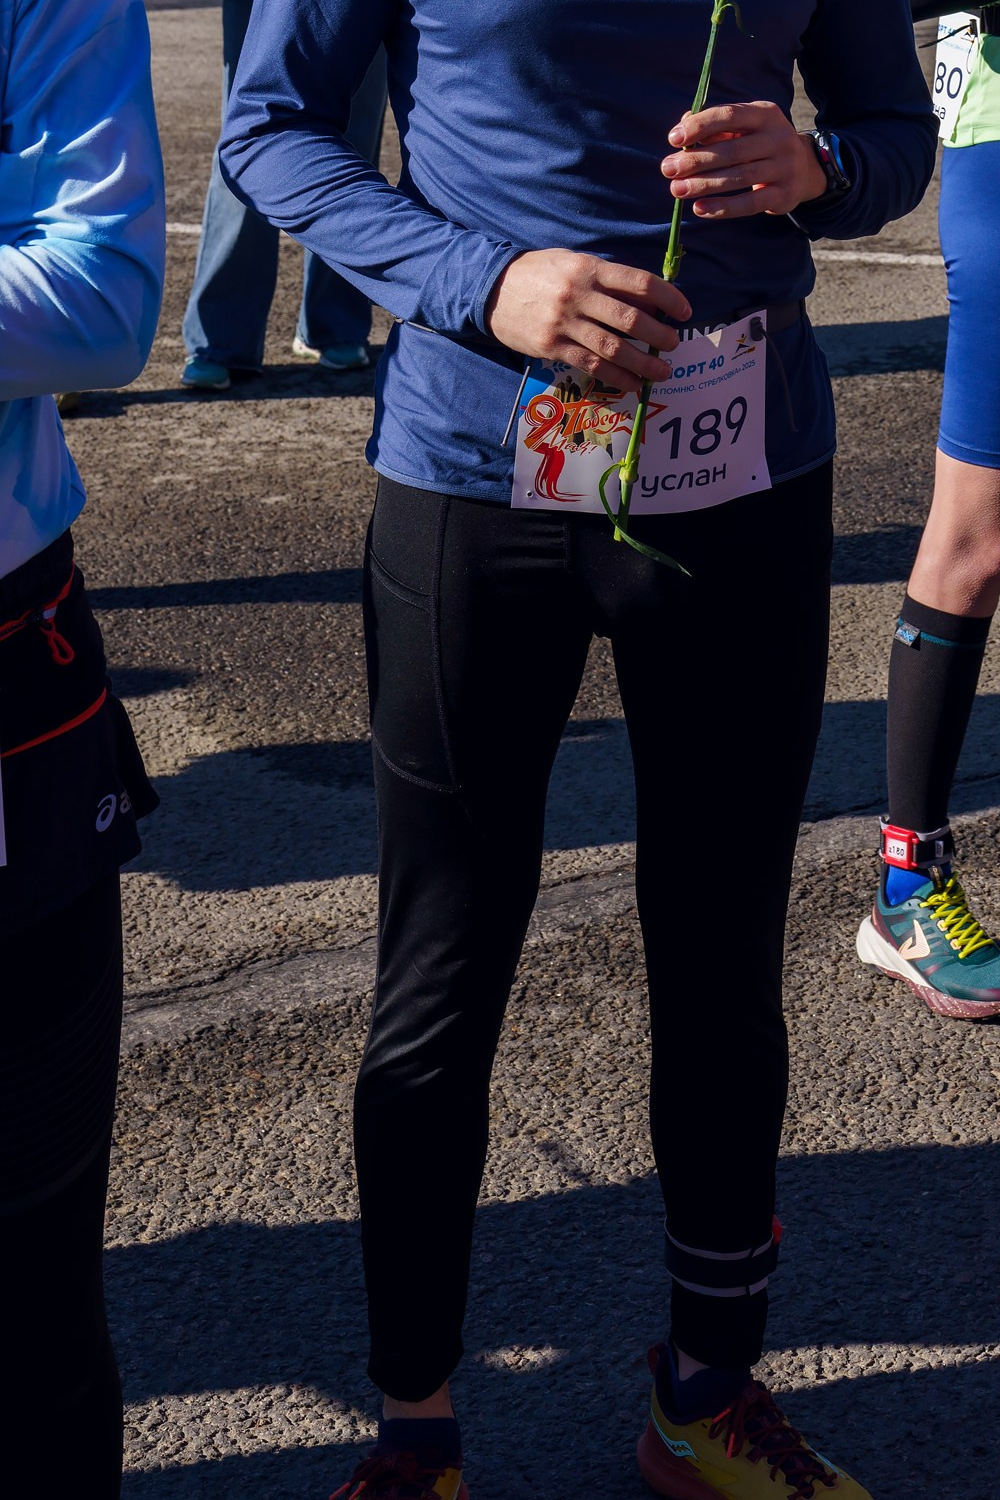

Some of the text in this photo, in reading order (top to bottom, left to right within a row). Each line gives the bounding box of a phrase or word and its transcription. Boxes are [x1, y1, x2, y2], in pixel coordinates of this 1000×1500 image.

[934, 61, 963, 100] 80
[660, 384, 697, 395] ПОМНЮ.
[741, 359, 756, 372] 2025
[708, 355, 725, 371] 40
[658, 395, 748, 460] 189
